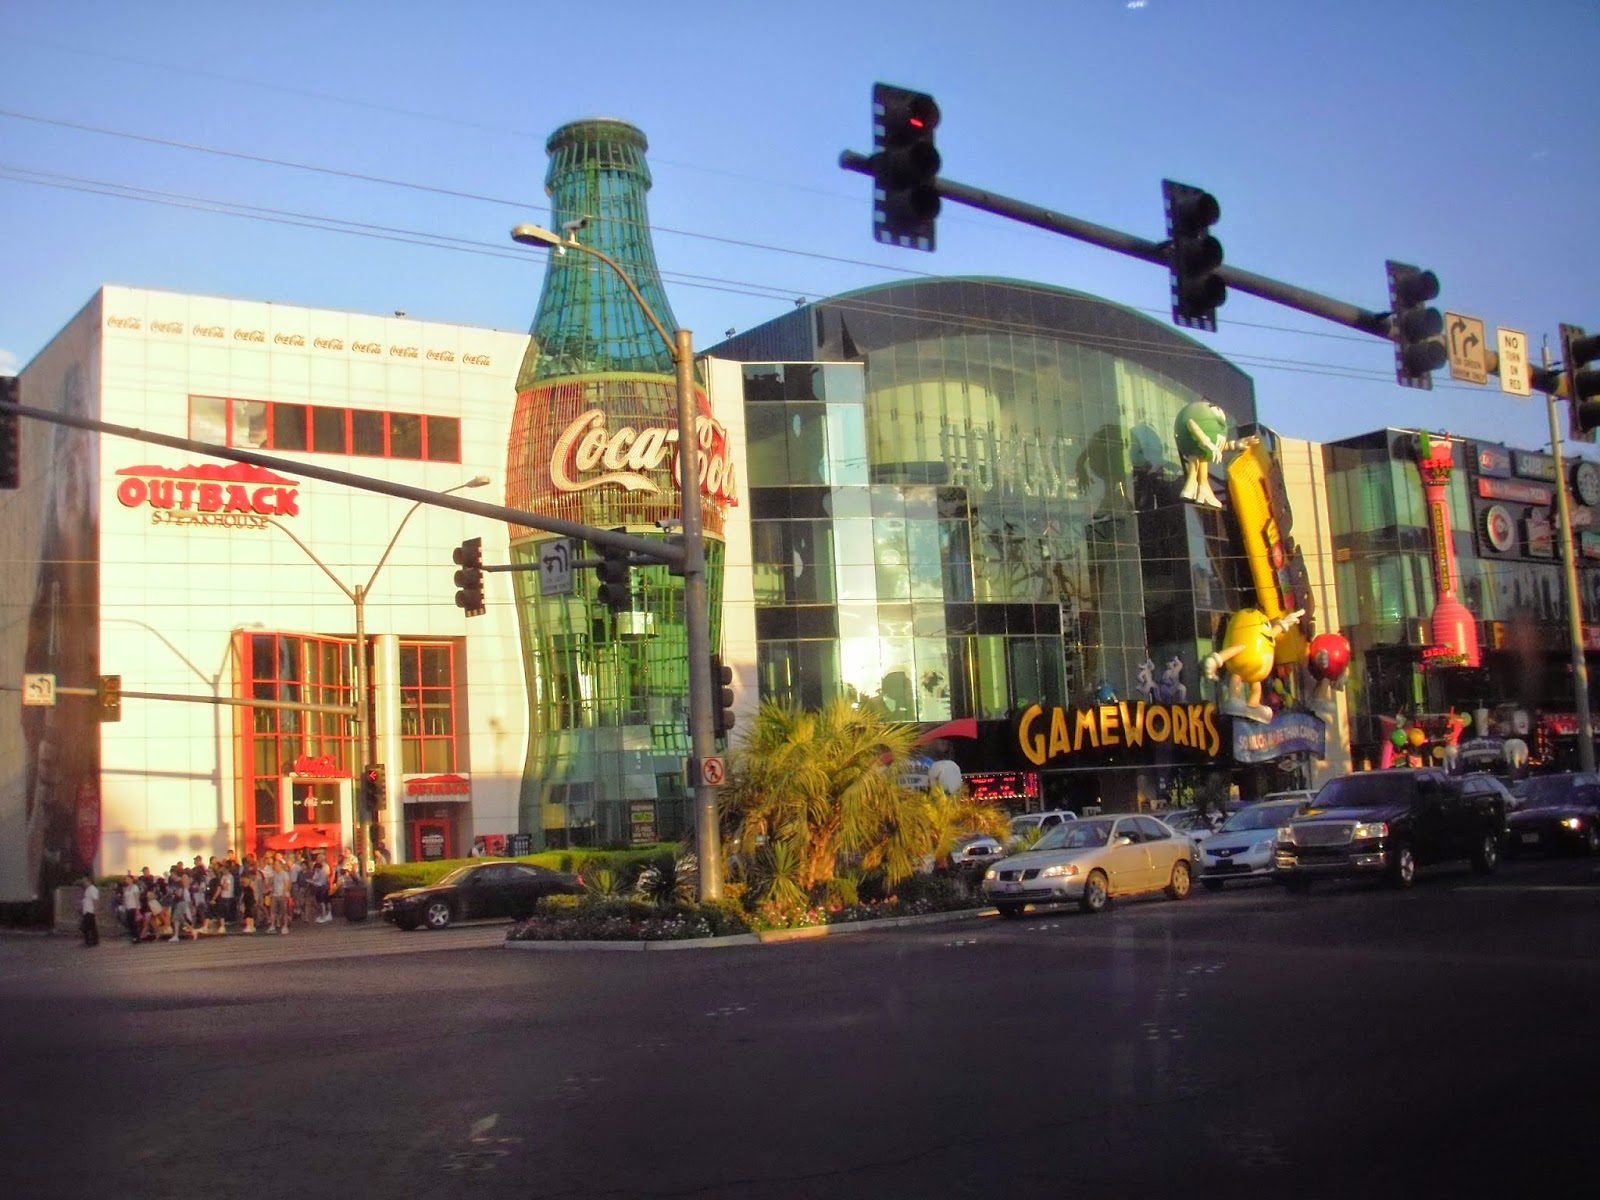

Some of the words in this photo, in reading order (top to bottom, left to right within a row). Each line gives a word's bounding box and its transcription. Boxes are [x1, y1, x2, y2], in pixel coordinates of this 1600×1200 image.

[1504, 335, 1519, 350] NO
[1509, 378, 1521, 390] RED
[117, 477, 300, 517] OUTBACK
[1018, 700, 1220, 766] GAMEWORKS
[407, 783, 470, 796] OUTBACK
